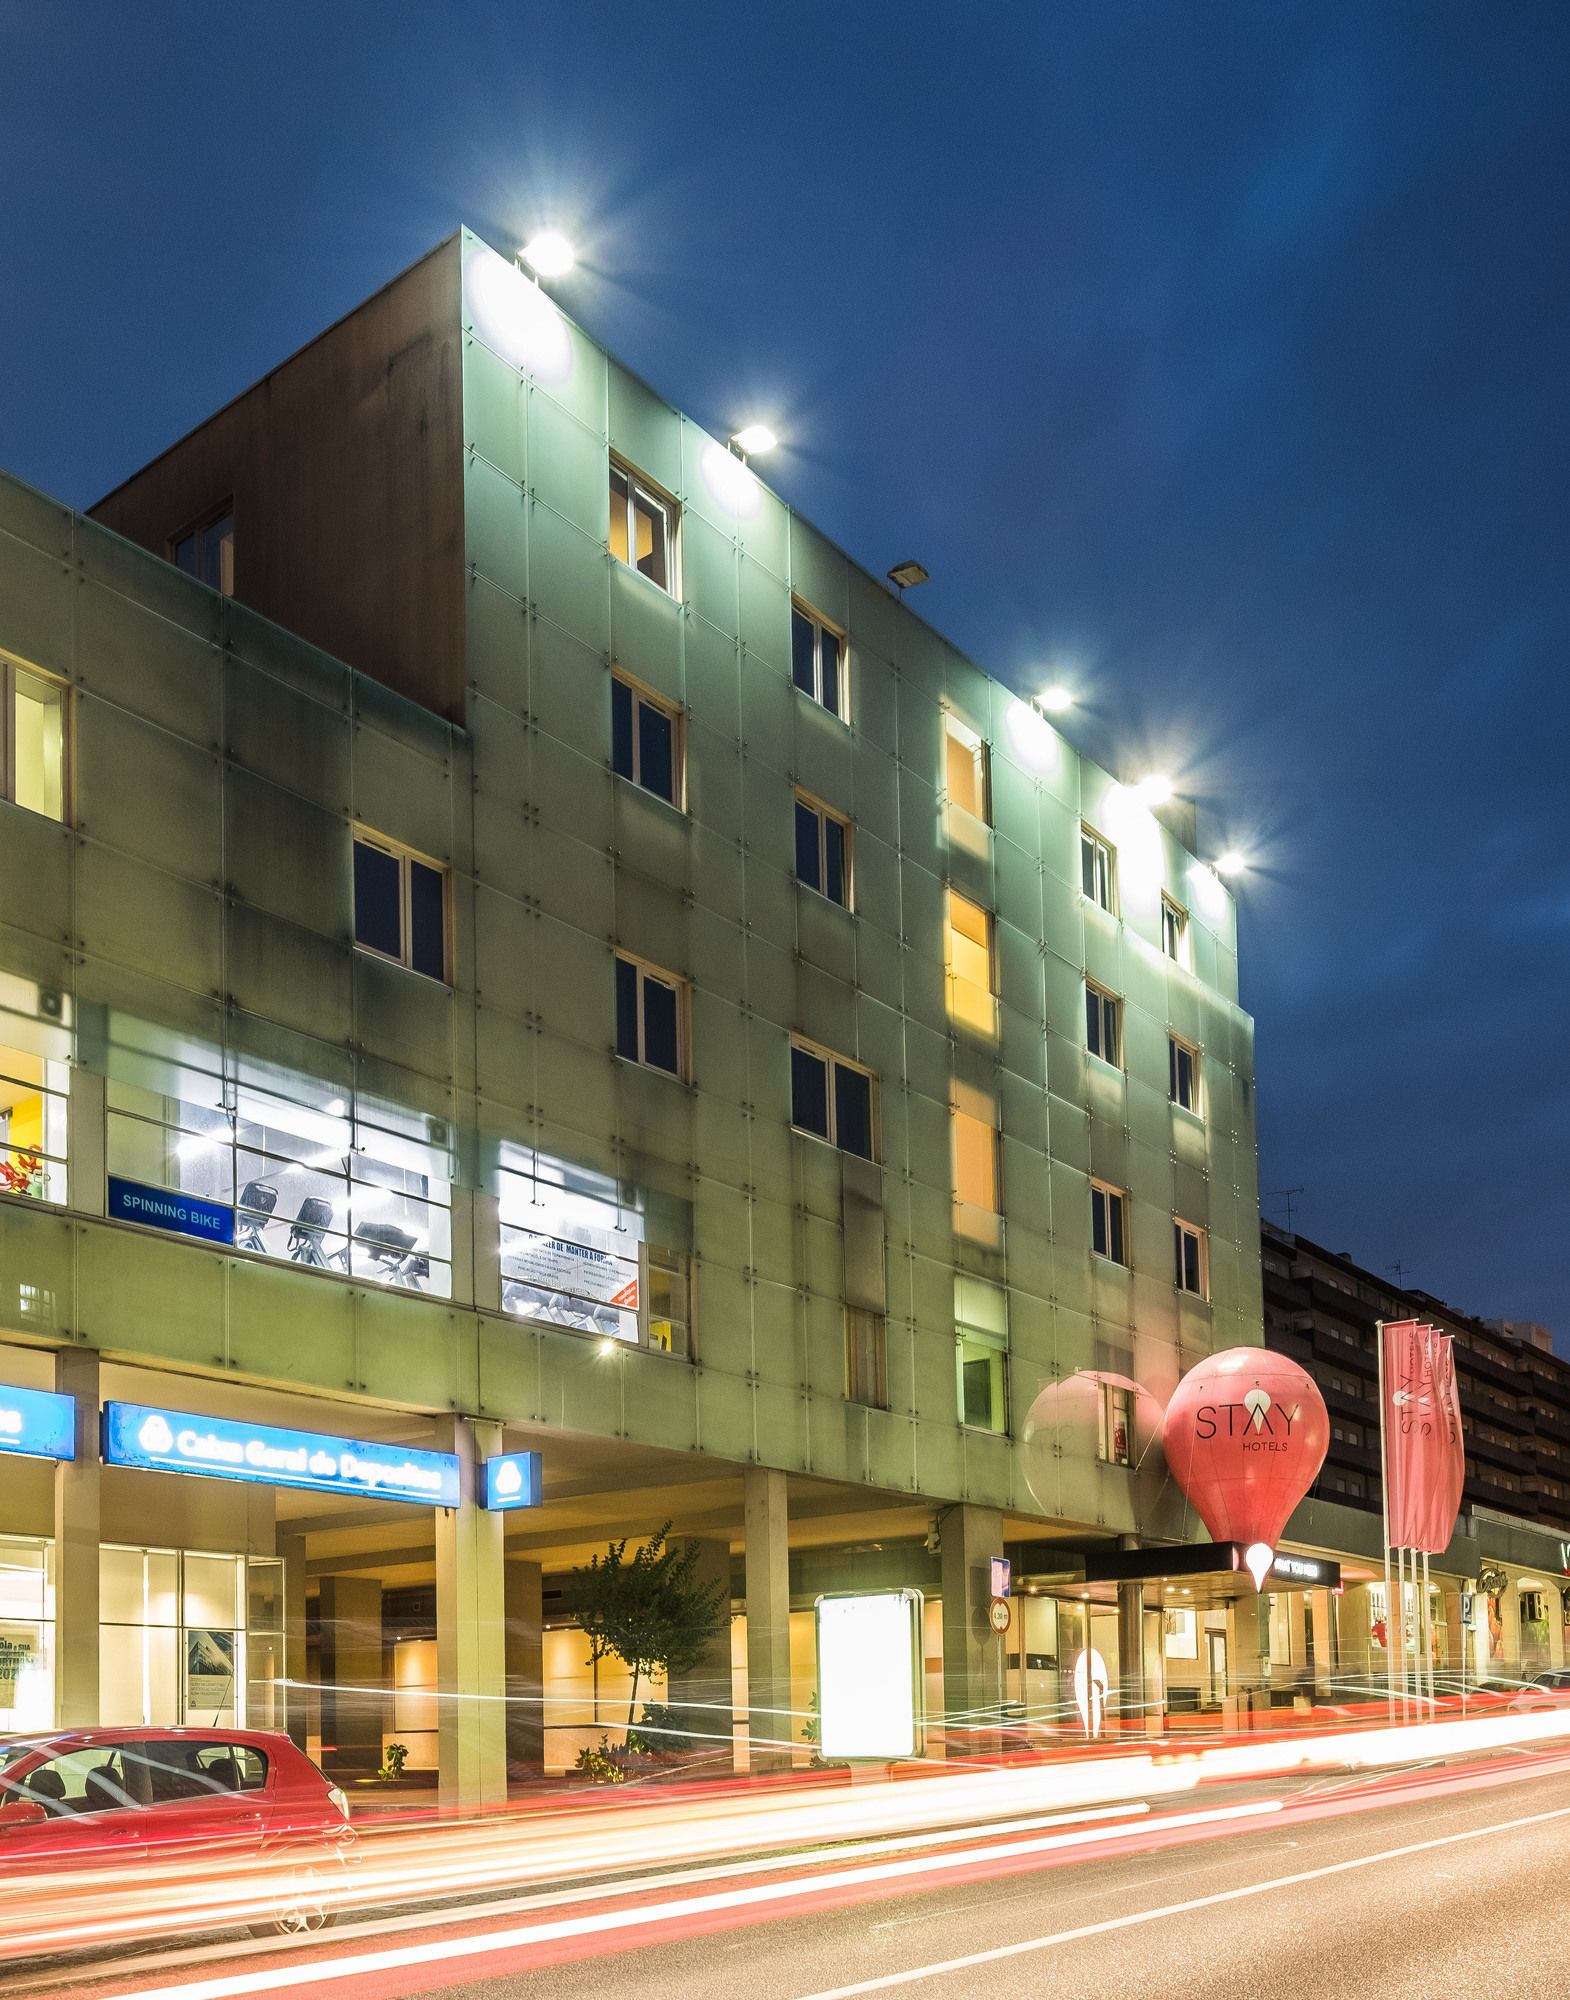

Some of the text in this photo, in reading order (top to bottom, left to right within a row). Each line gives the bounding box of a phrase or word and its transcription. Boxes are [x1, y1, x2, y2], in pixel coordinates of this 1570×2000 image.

[123, 1194, 221, 1230] SPINNING BIKE
[556, 1242, 564, 1252] DE
[566, 1244, 588, 1259] MANTER
[1196, 1402, 1299, 1439] STAY
[1242, 1441, 1288, 1452] HOTELS
